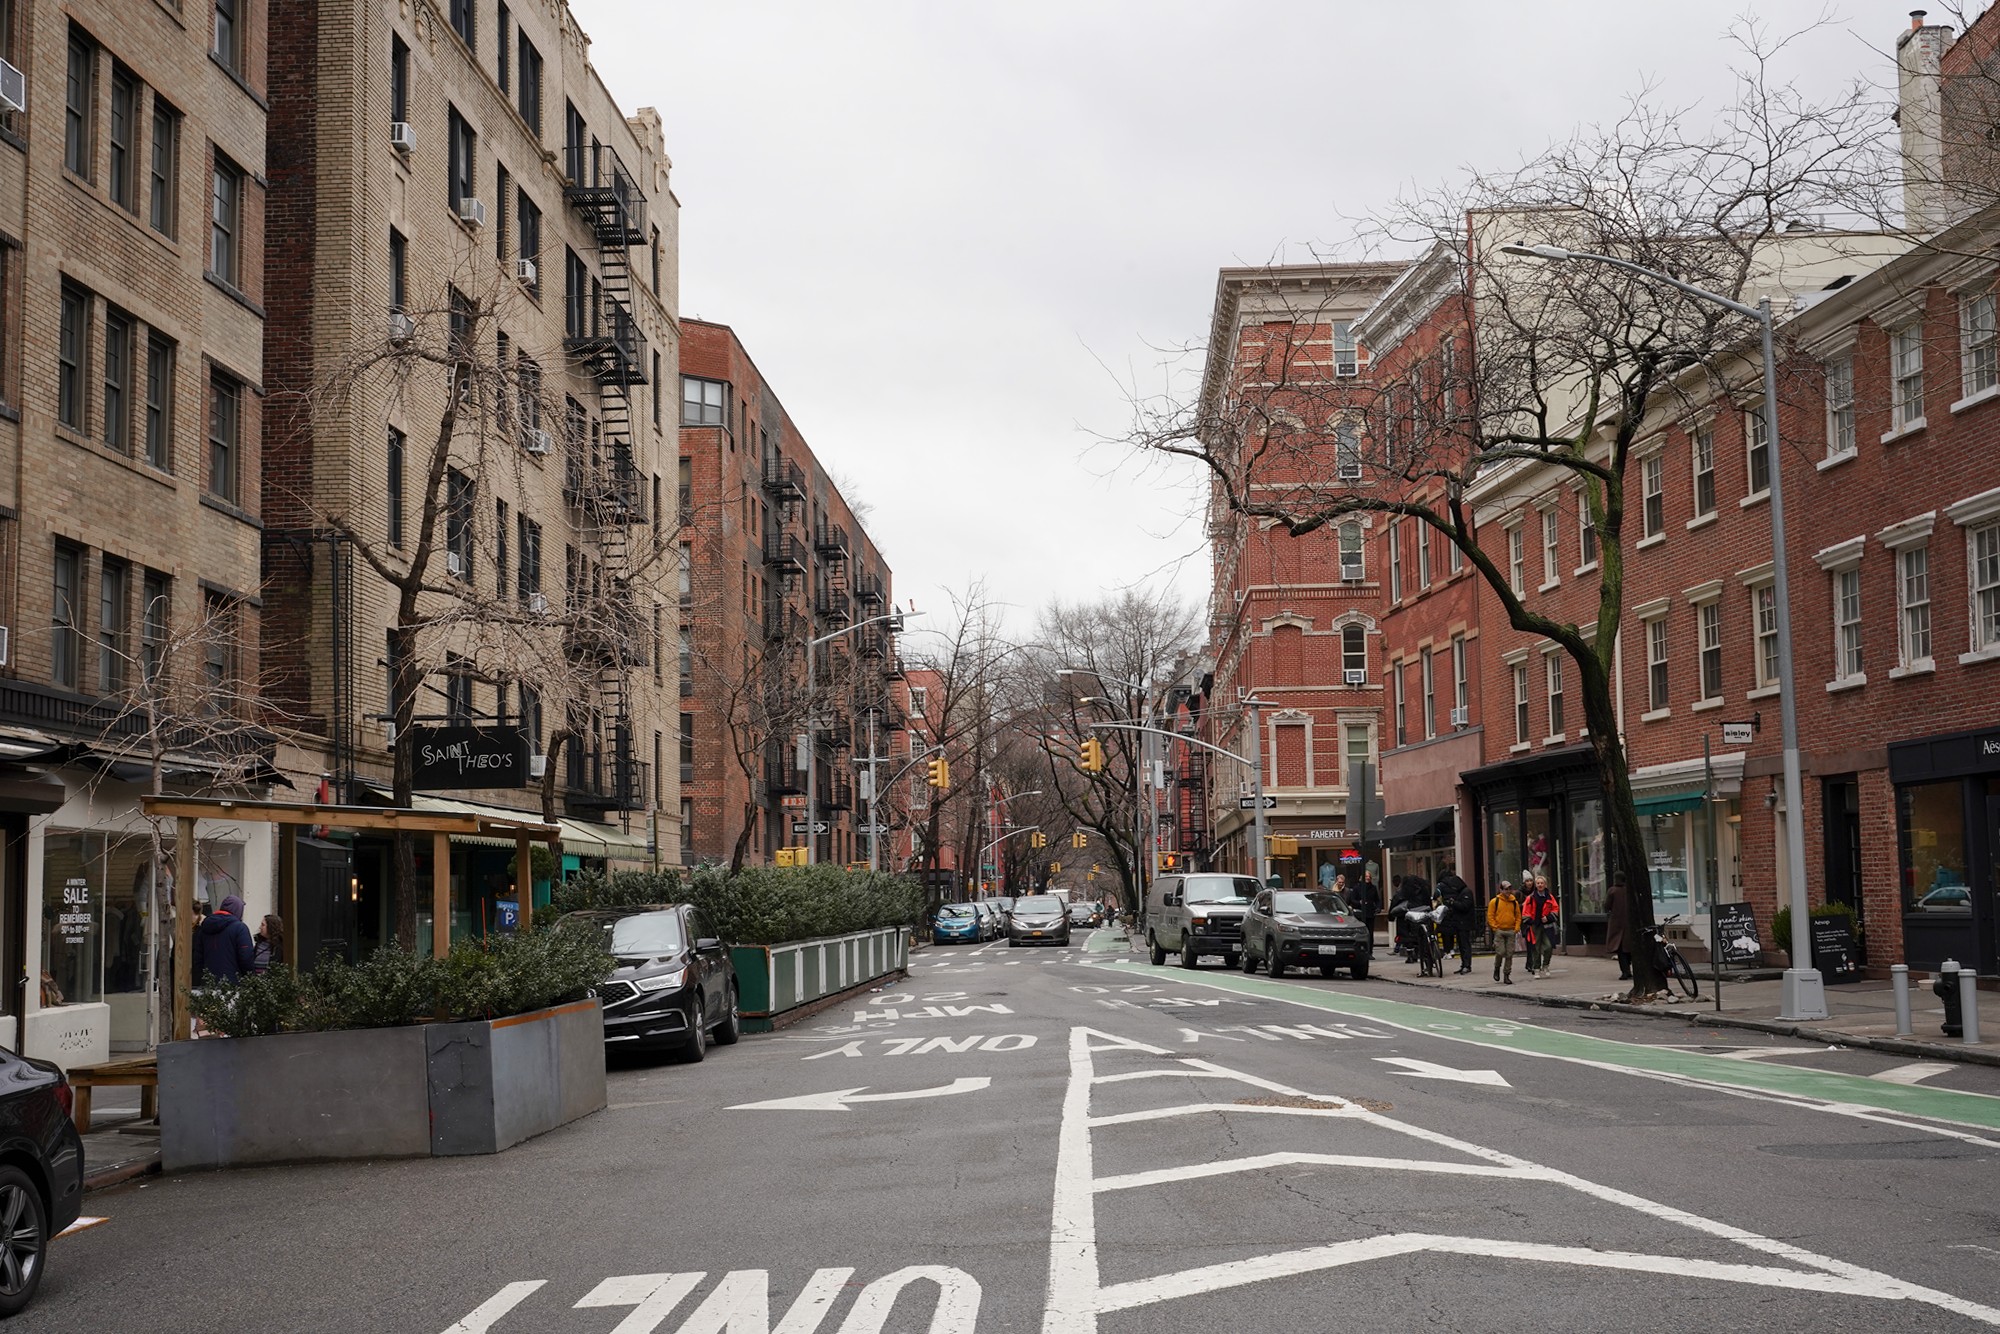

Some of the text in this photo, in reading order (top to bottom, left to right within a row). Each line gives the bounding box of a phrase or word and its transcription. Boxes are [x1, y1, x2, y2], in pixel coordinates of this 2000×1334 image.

[421, 740, 469, 766] SAINT
[454, 753, 513, 775] THEO'S
[1310, 830, 1345, 838] FAHERTY
[63, 888, 88, 904] SALE
[72, 905, 79, 913] TO
[59, 913, 91, 923] REMEMBER
[1718, 914, 1754, 928] great skin
[1068, 985, 1164, 993] 20
[868, 991, 969, 1005] 20
[852, 1003, 1015, 1023] MPH
[800, 1033, 1039, 1061] ONLY
